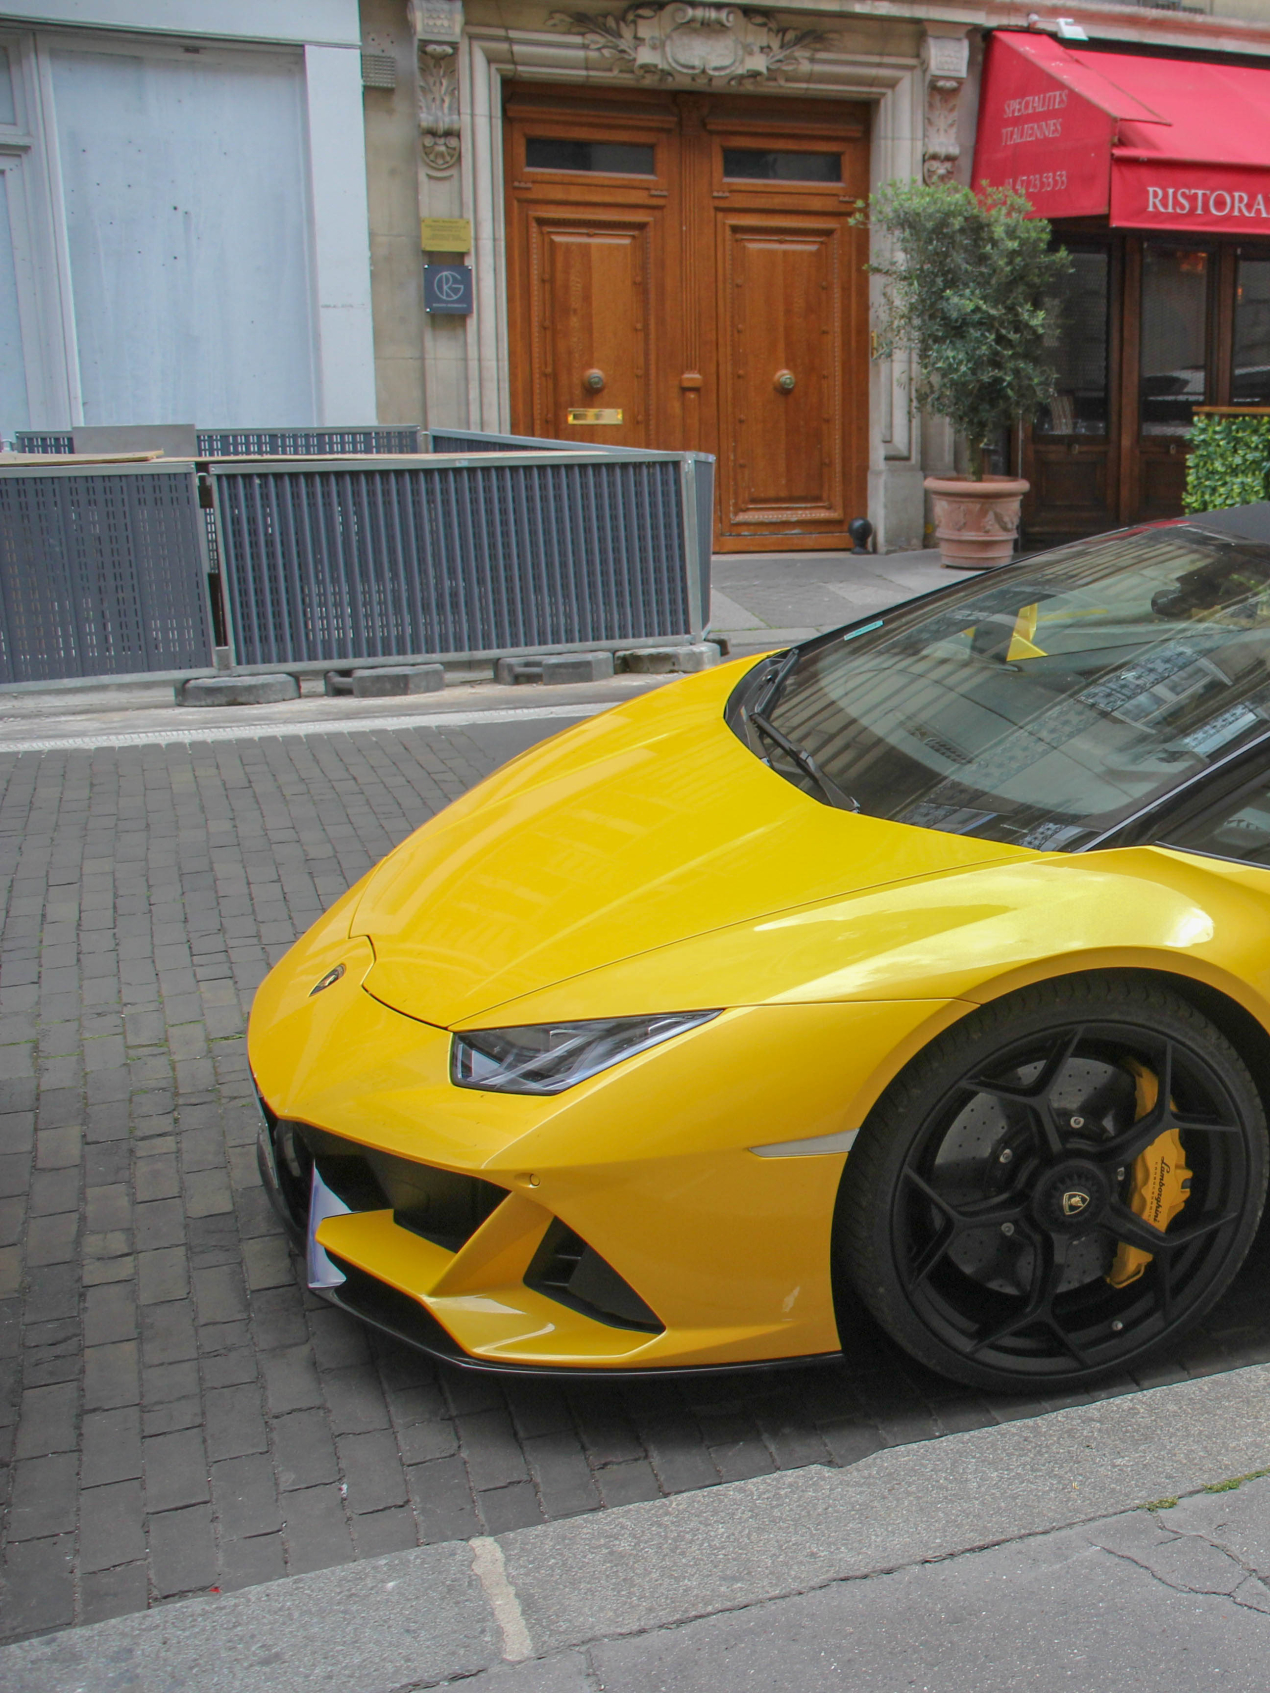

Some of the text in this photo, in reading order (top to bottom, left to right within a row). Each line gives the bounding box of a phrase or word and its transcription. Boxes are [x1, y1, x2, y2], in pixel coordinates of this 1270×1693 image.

[1003, 89, 1068, 118] SPECIALITES
[1001, 118, 1062, 145] ITALIENNES
[1029, 174, 1040, 192] 23
[1041, 172, 1053, 192] 53
[1055, 170, 1067, 190] 53
[1153, 1156, 1170, 1223] Lamborghini
